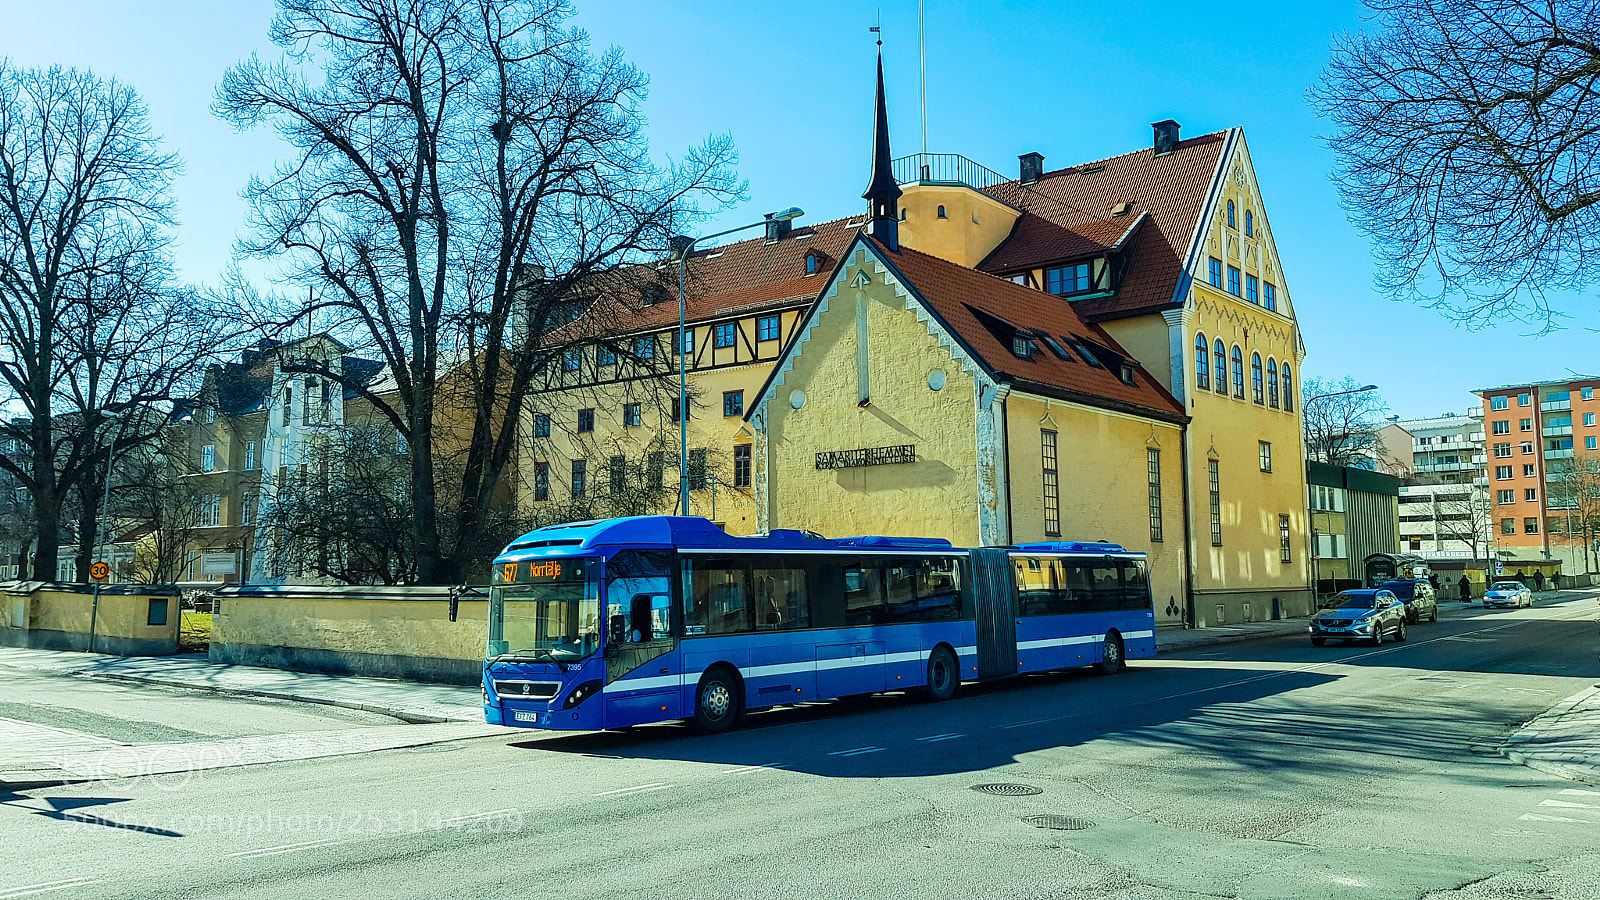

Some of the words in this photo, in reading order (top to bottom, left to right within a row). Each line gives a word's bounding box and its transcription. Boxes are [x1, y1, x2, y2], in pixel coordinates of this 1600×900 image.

[815, 445, 915, 461] SAMARITERHEMMET
[93, 566, 106, 575] 30
[504, 563, 518, 582] 677
